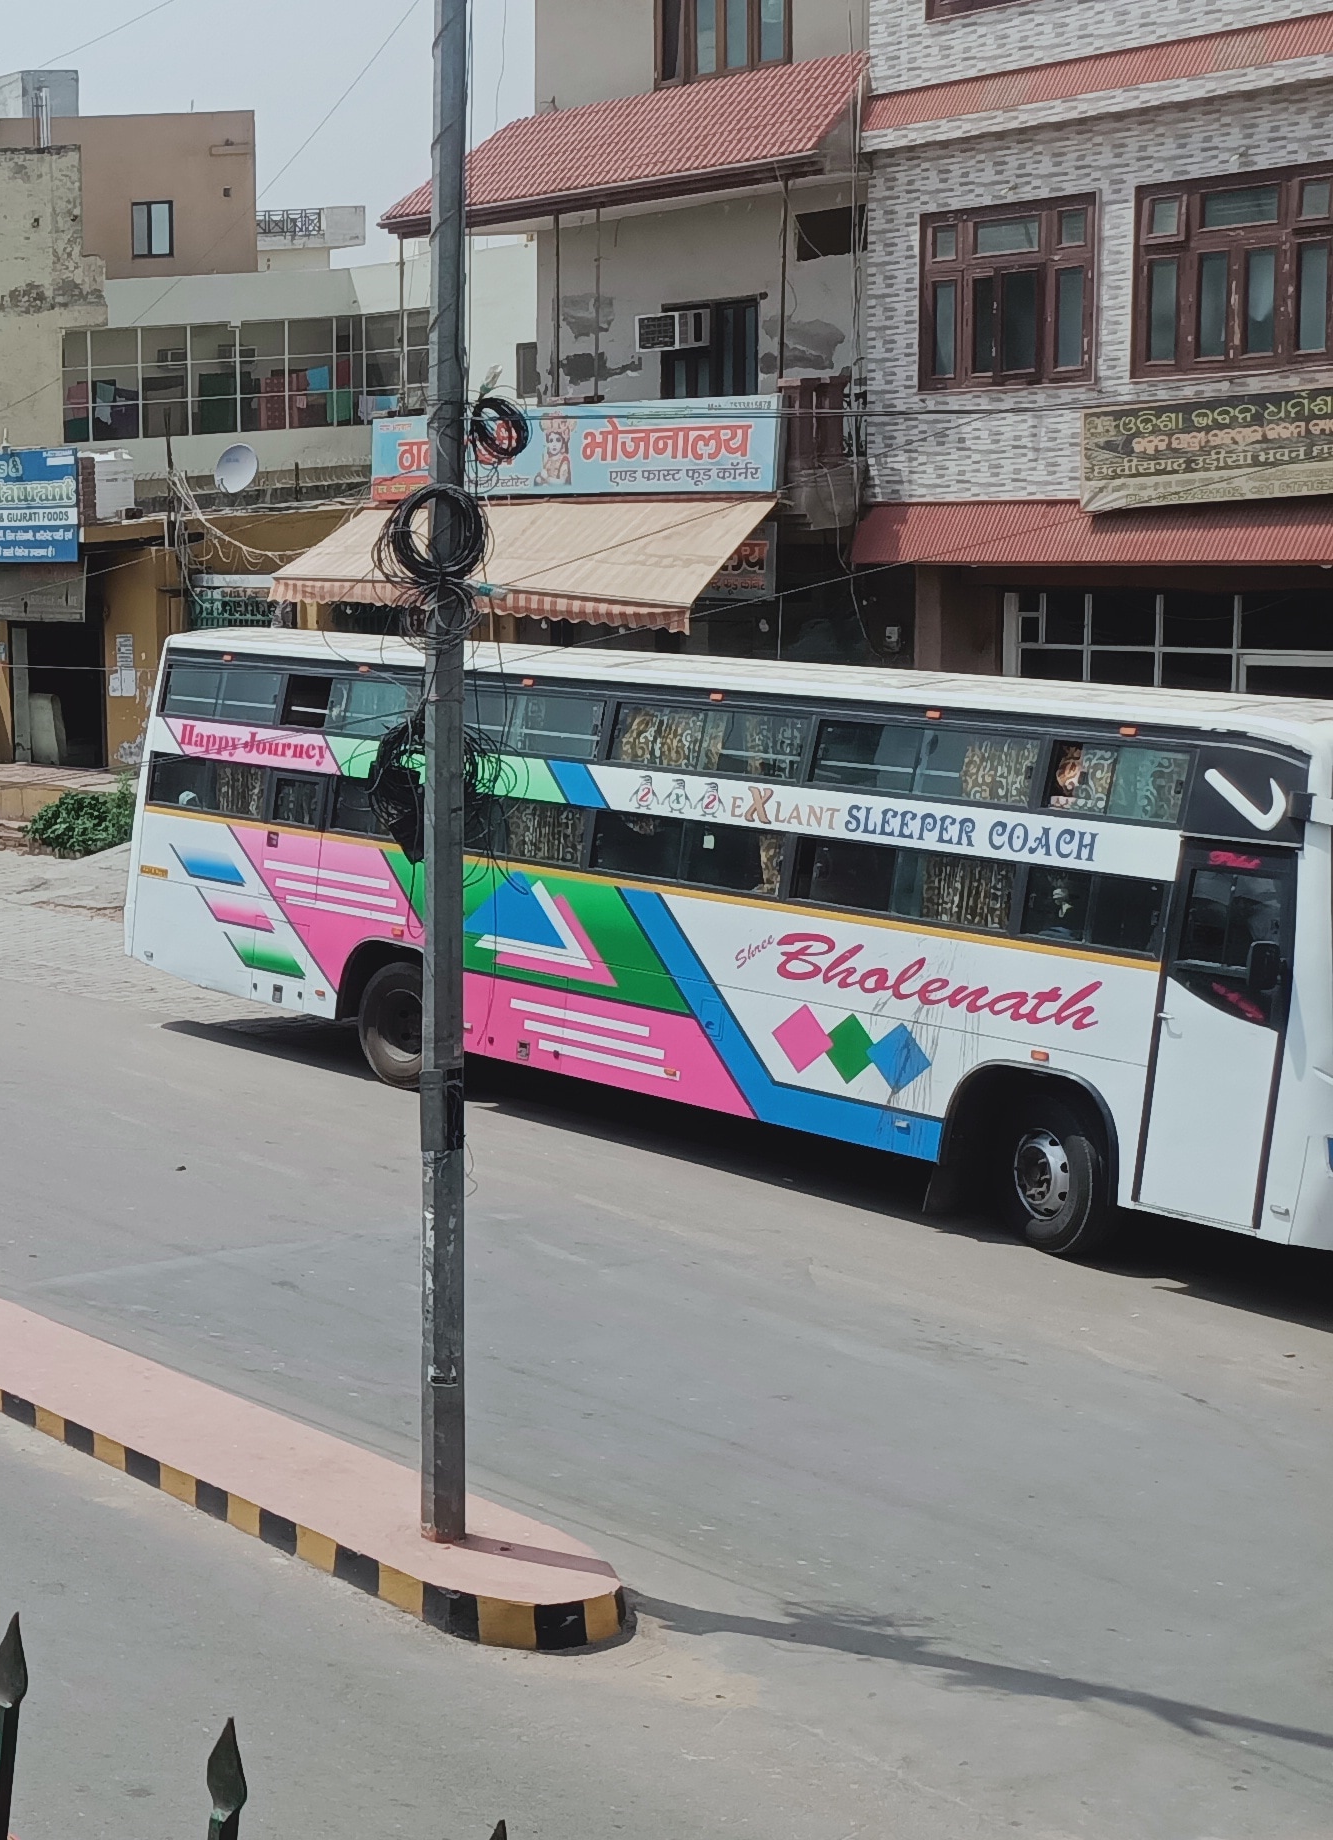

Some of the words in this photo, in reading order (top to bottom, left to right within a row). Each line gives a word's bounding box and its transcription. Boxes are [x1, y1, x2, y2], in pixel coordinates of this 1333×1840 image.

[582, 417, 753, 462] भोजनालय
[1258, 446, 1308, 463] भवन
[9, 457, 22, 475] &
[609, 470, 637, 487] एण्ड
[641, 468, 683, 484] फास्ट
[685, 467, 713, 486] फूड
[716, 461, 761, 480] कॉर्नर
[0, 512, 5, 523] &
[7, 511, 40, 522] GUJRATI
[42, 511, 69, 522] FOODS
[180, 722, 242, 758] Happy
[244, 731, 328, 767] Journey
[844, 804, 976, 848] SLEEPER
[988, 820, 1100, 862] COACH
[735, 934, 776, 970] Shree
[776, 932, 1103, 1031] Bholenath
